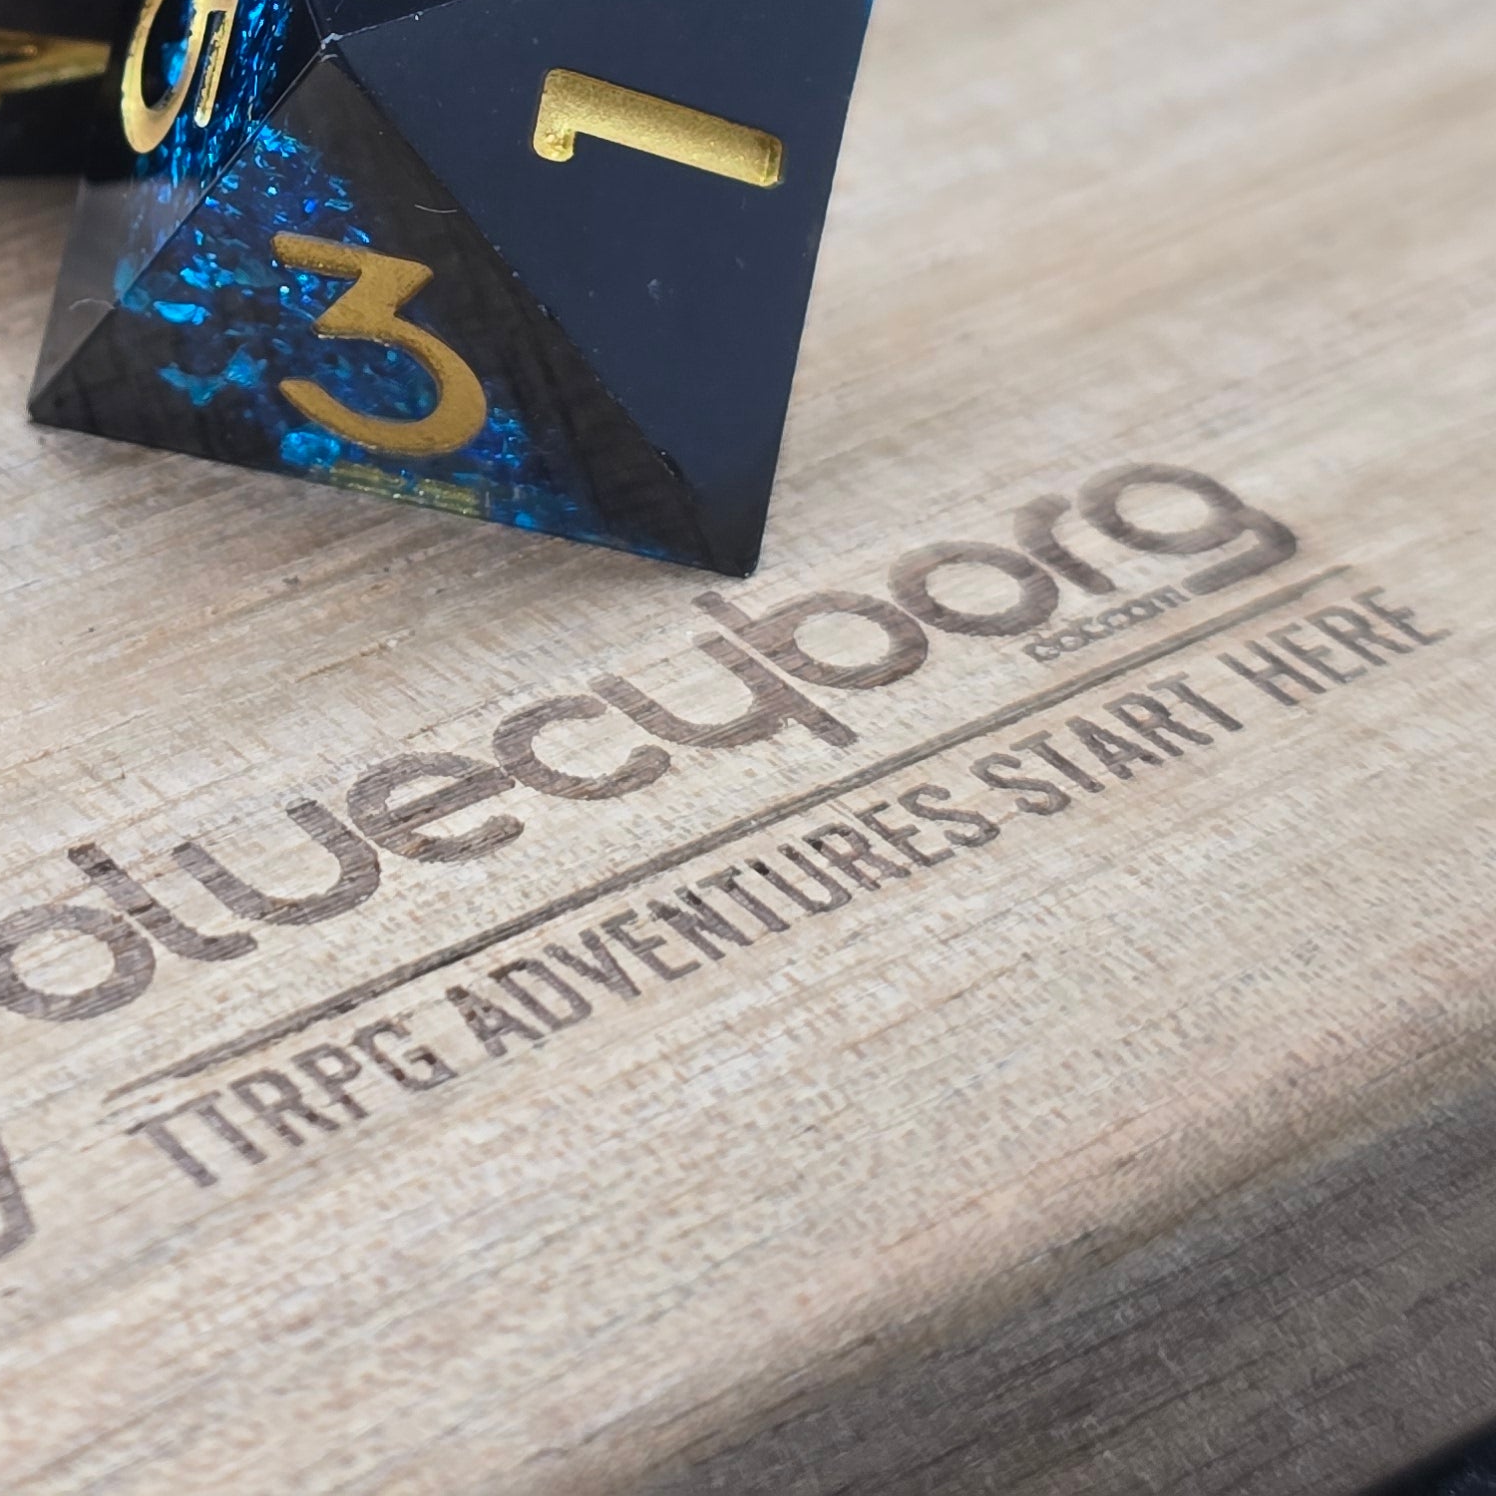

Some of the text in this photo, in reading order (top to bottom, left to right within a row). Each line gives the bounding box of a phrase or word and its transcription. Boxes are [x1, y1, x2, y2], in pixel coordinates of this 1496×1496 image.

[532, 67, 785, 190] 1
[269, 230, 488, 459] 3
[125, 585, 1452, 1189] TTRPG ADVENTURES START HERE
